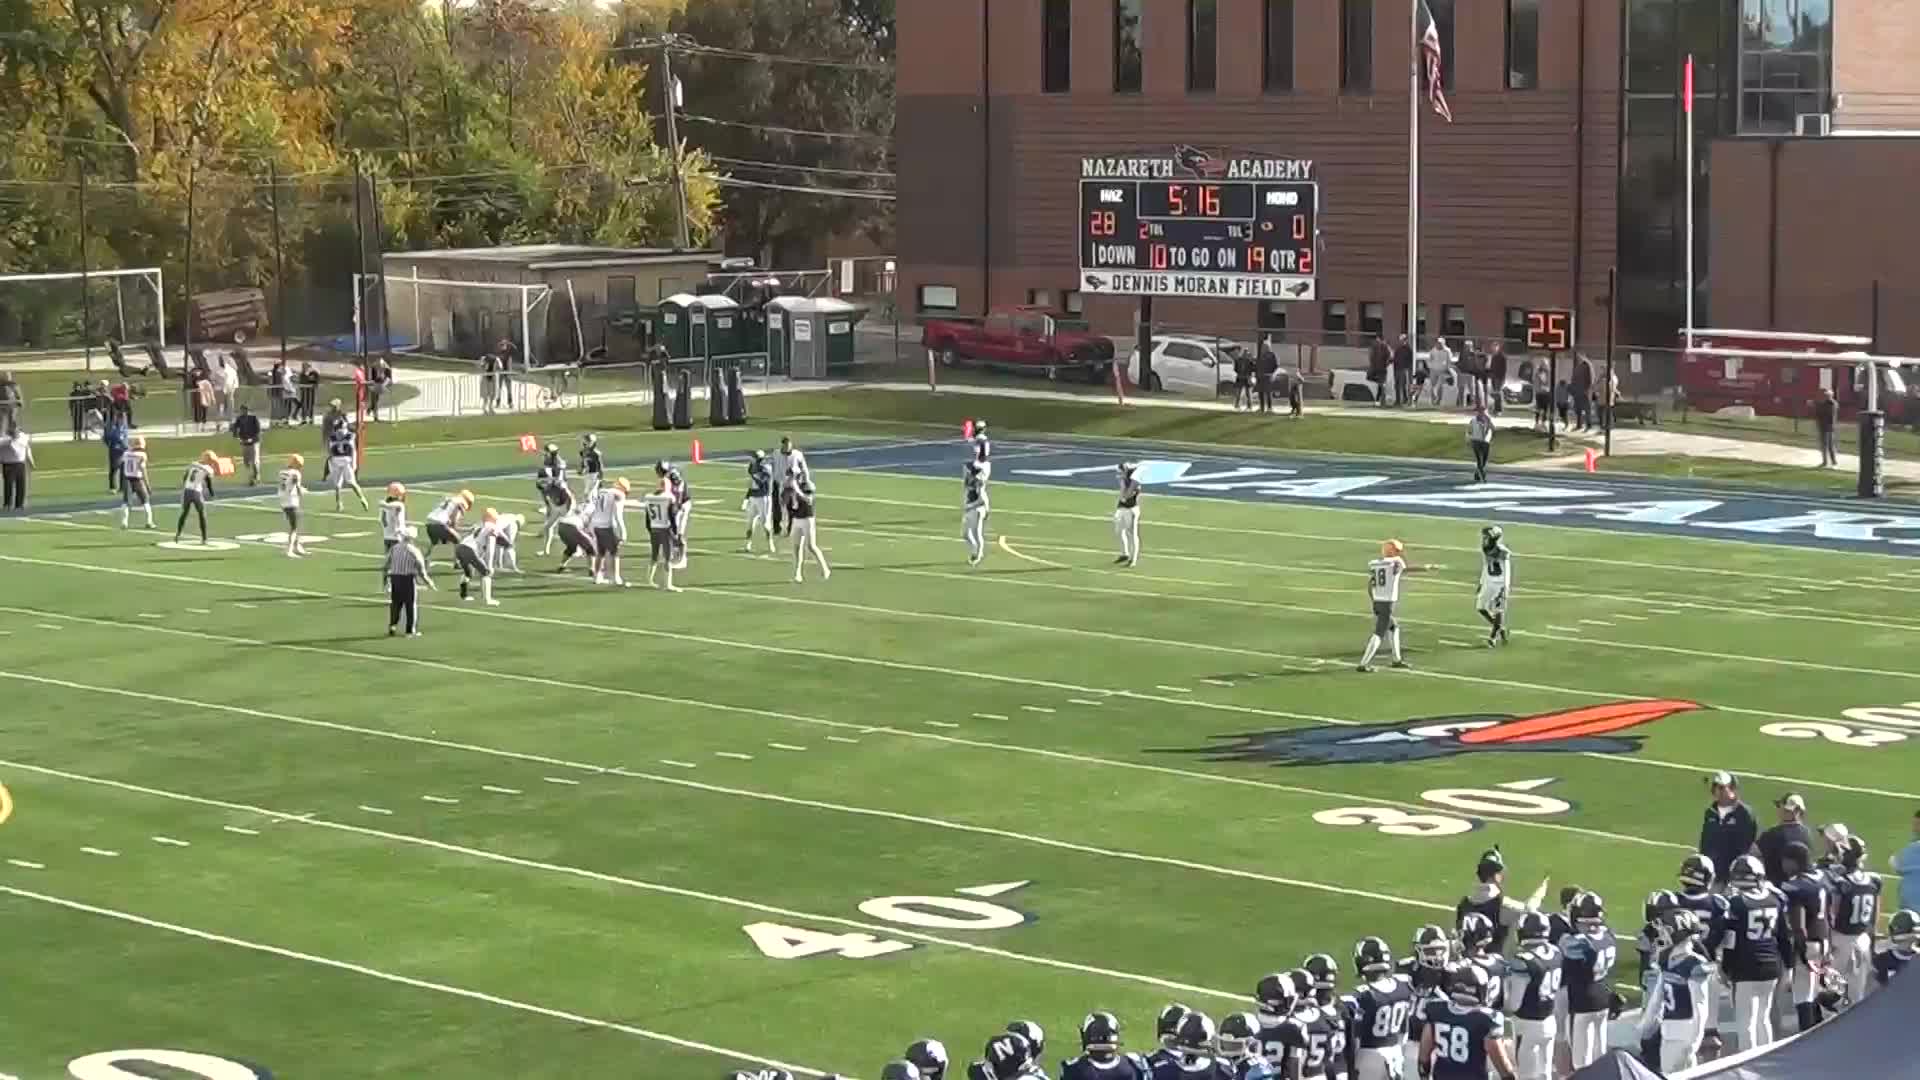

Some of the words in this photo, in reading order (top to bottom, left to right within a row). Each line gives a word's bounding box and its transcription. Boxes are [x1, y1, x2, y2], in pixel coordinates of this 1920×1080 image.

[1082, 159, 1174, 177] NAZARETH
[1227, 159, 1313, 179] ACADEMY
[1168, 185, 1220, 216] 5:16
[1091, 211, 1115, 235] 28
[1293, 214, 1305, 240] 0
[1099, 245, 1136, 265] DOWN
[1150, 244, 1167, 270] 10
[1170, 247, 1186, 266] TO
[1192, 248, 1210, 267] GO
[1218, 248, 1236, 268] ON
[1247, 246, 1265, 272] 19
[1270, 248, 1296, 272] QTR
[1299, 248, 1312, 273] 2
[1112, 274, 1169, 293] DENNIS
[1174, 277, 1229, 294] MORAN
[1235, 279, 1282, 297] FIELD
[1527, 313, 1565, 348] 25
[1312, 787, 1572, 837] 30
[742, 894, 1026, 959] 40
[1746, 906, 1778, 940] 57
[1372, 1000, 1410, 1037] 80
[993, 1037, 1015, 1061] N
[1434, 1022, 1470, 1064] 58
